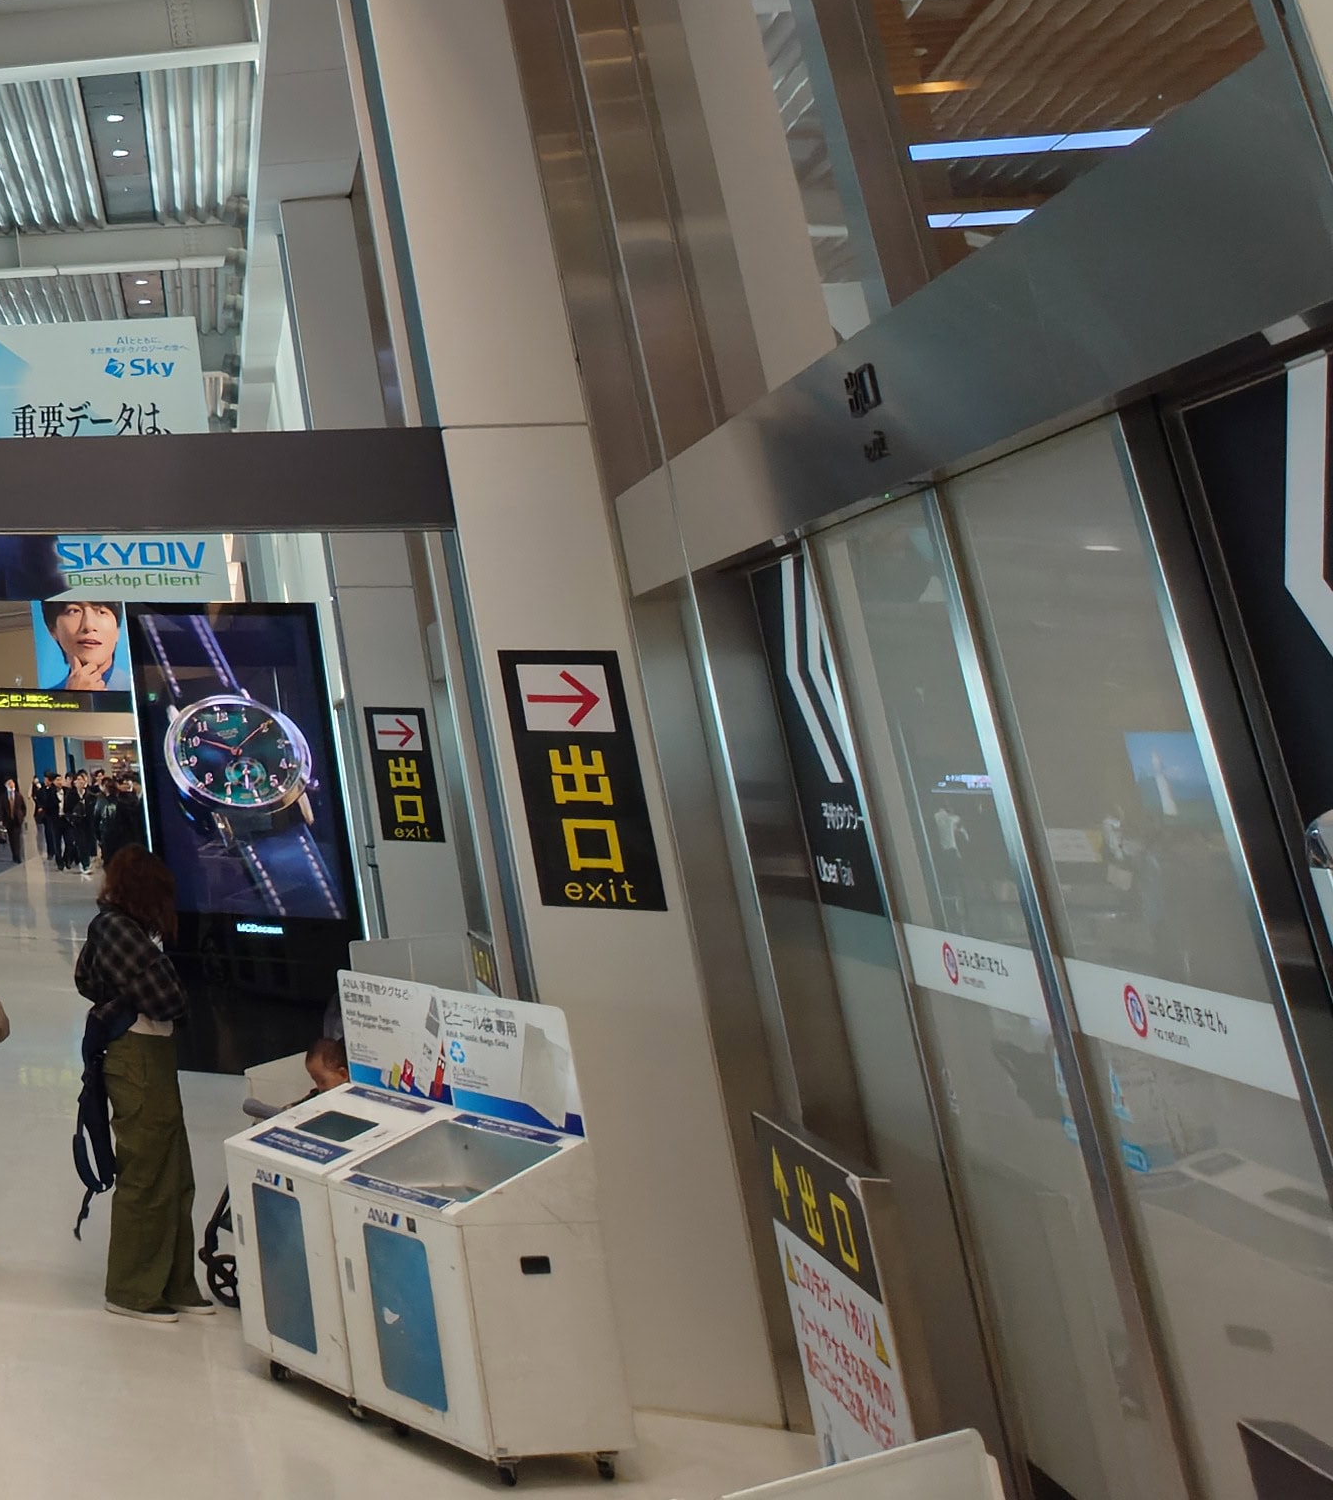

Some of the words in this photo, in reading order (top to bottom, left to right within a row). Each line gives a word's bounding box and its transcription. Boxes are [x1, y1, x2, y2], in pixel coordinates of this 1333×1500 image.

[129, 358, 175, 378] Sky
[843, 362, 883, 418] 出口
[11, 401, 172, 438] 重要データは、
[55, 541, 206, 570] SKYDIV
[68, 573, 142, 589] Desktop
[145, 573, 203, 587] Client
[388, 756, 426, 824] 出口
[548, 744, 625, 873] 出口
[394, 826, 432, 841] exit
[815, 855, 839, 884] Uber
[564, 878, 638, 904] exit
[1144, 993, 1228, 1035] 出ると戻れません
[255, 1168, 274, 1183] ANA
[367, 1207, 390, 1225] ANA
[794, 1165, 860, 1273] 出口
